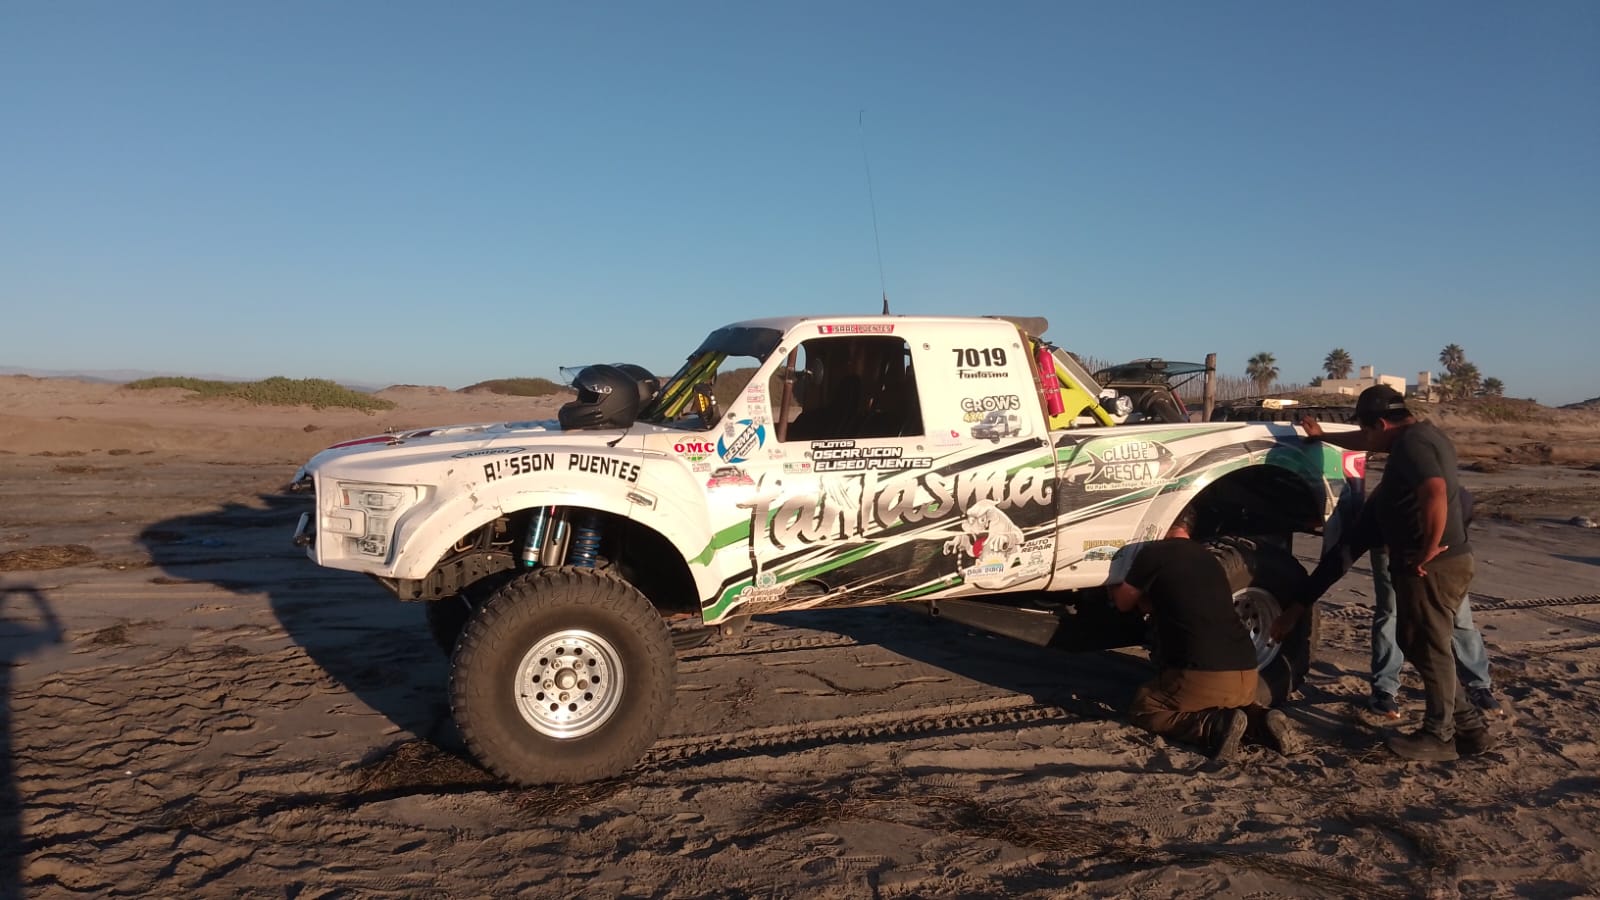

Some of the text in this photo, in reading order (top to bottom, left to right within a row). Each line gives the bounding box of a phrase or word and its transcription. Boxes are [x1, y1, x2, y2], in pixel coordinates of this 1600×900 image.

[951, 347, 1007, 368] 7019
[960, 394, 1020, 413] CROWS
[673, 442, 715, 453] OMC
[811, 440, 854, 449] PILOTOS
[813, 447, 902, 460] OSCAR LICON
[1103, 442, 1140, 461] CLUB
[568, 453, 641, 483] PUENTES
[867, 458, 932, 470] PUENTES
[1105, 462, 1152, 481] PESCA
[1021, 543, 1053, 553] REPAIR
[1025, 538, 1049, 548] AUTO
